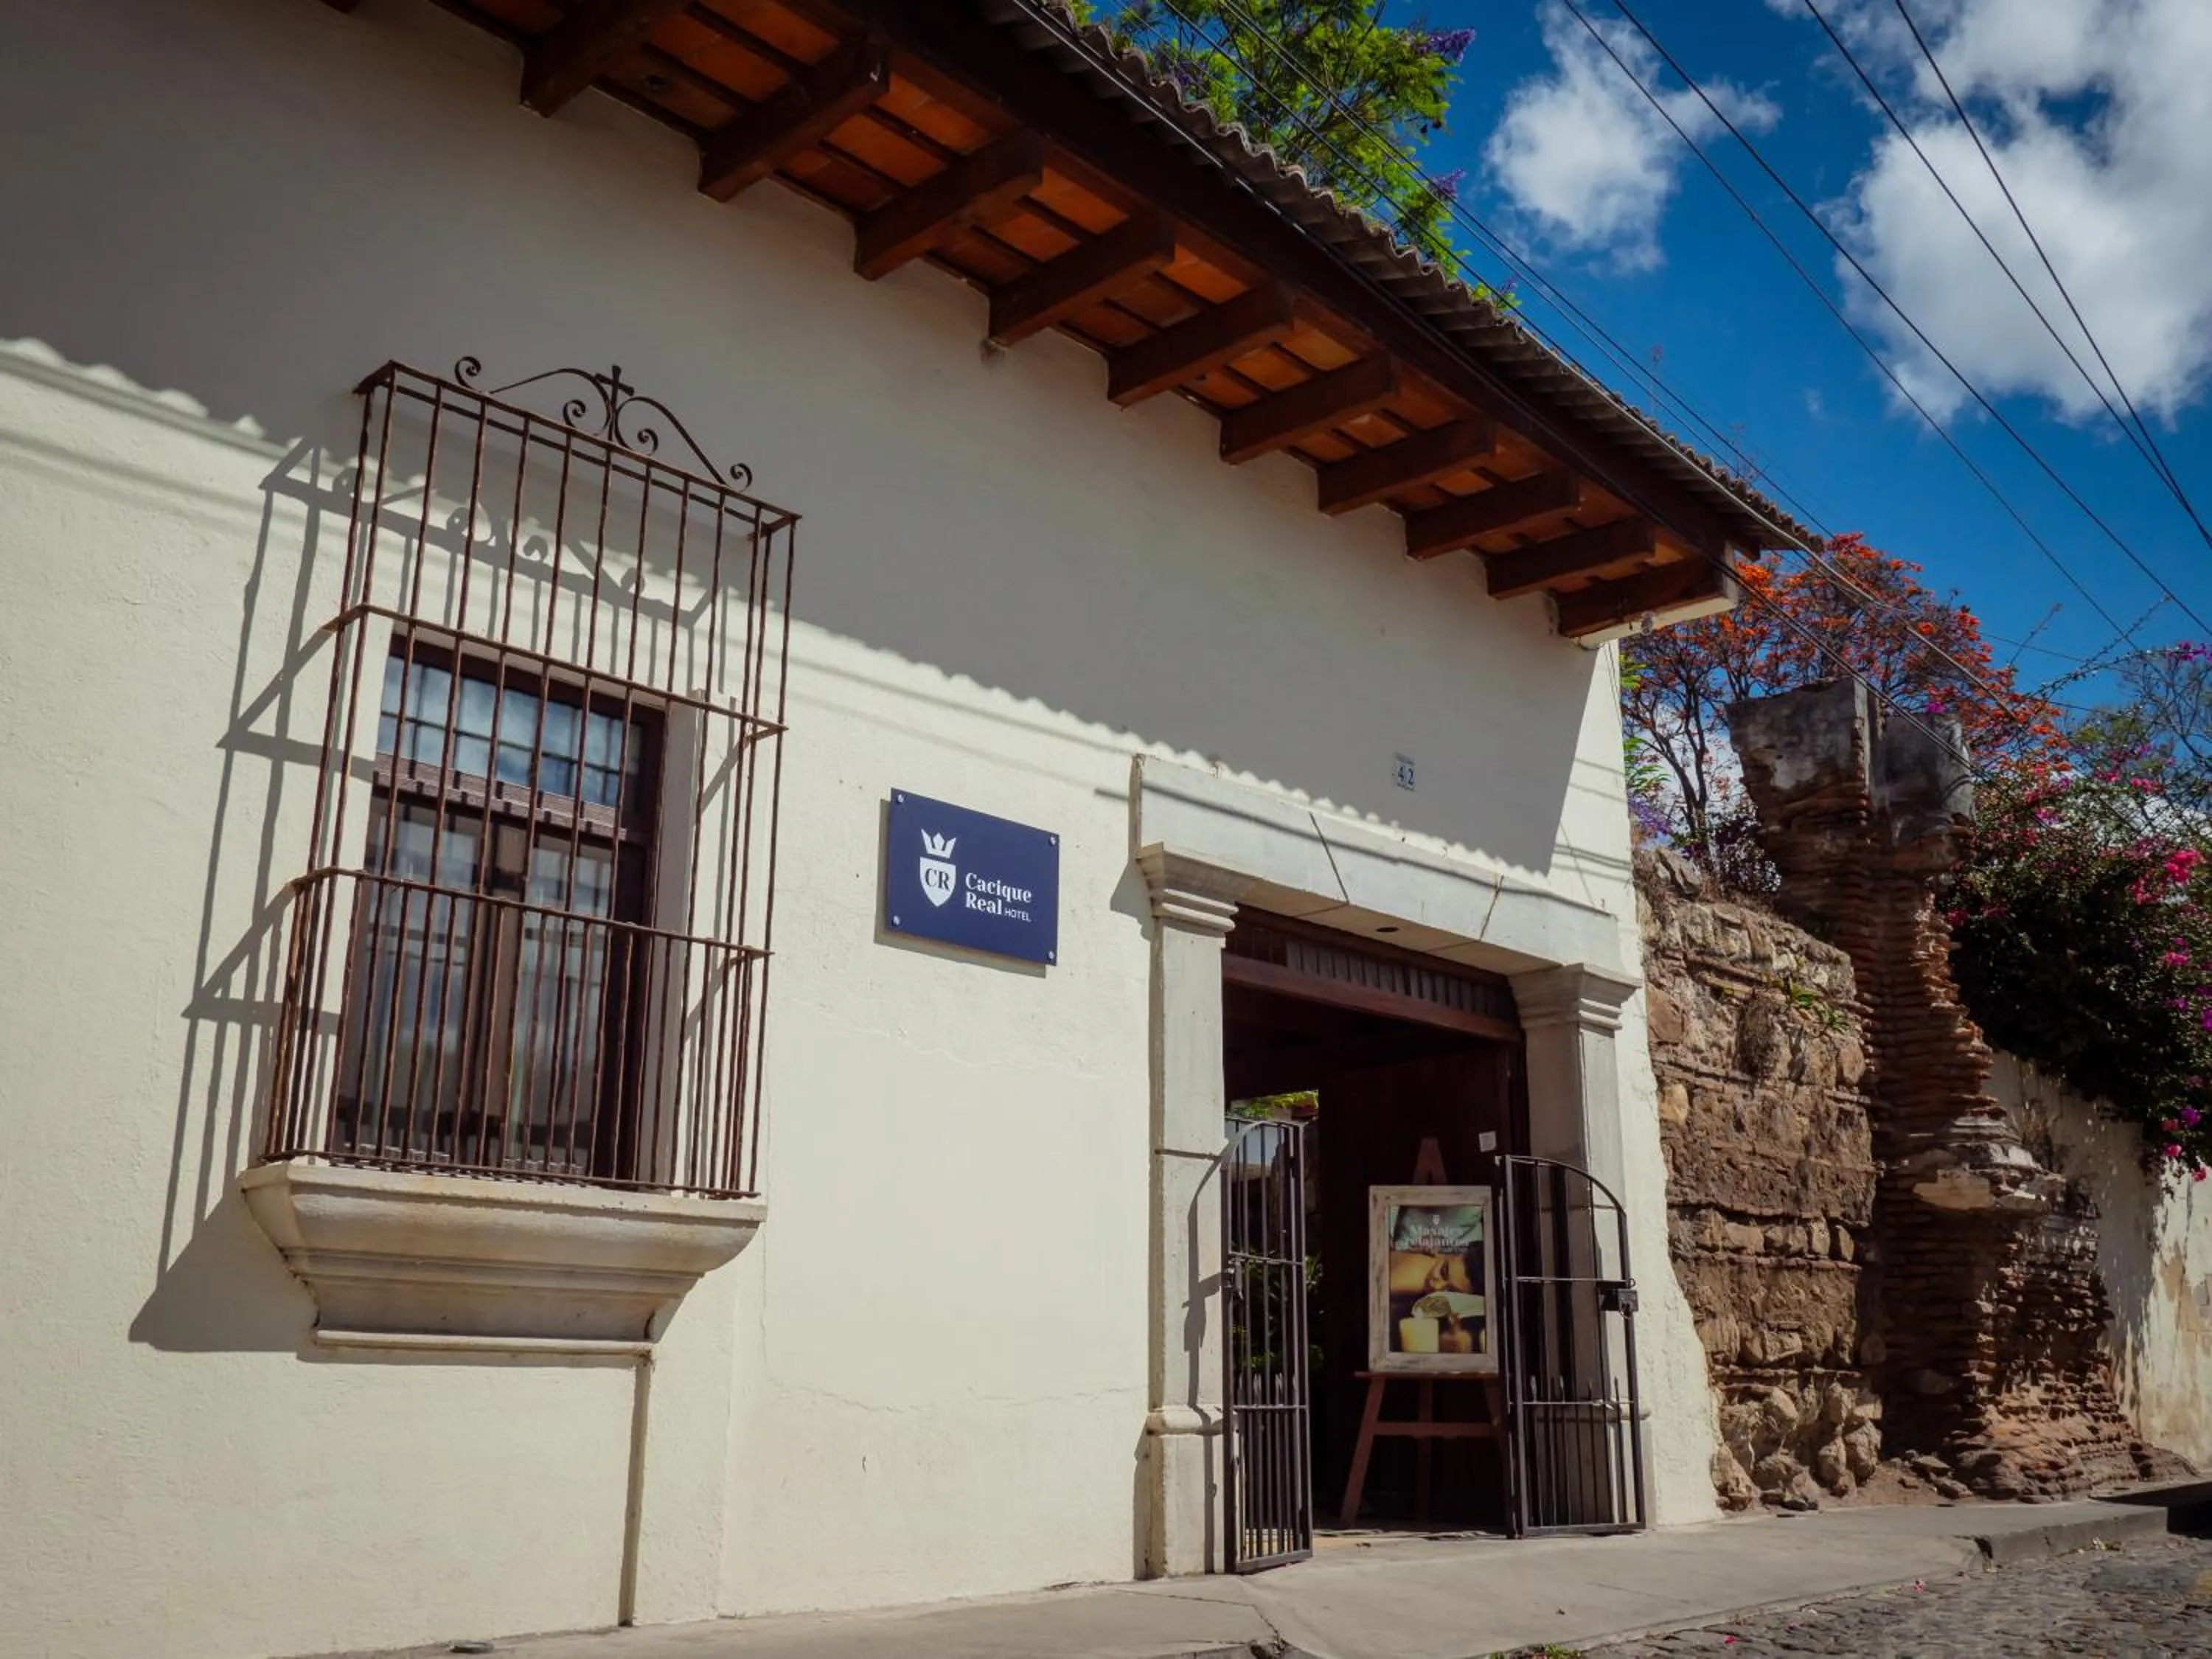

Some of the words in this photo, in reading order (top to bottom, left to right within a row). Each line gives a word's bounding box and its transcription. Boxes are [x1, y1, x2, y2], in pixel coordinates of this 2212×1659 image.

[1397, 766, 1413, 786] 42
[925, 868, 950, 891] CR
[965, 872, 1032, 903] Cacique
[965, 891, 1003, 915] Real
[1004, 908, 1032, 922] HOTEL
